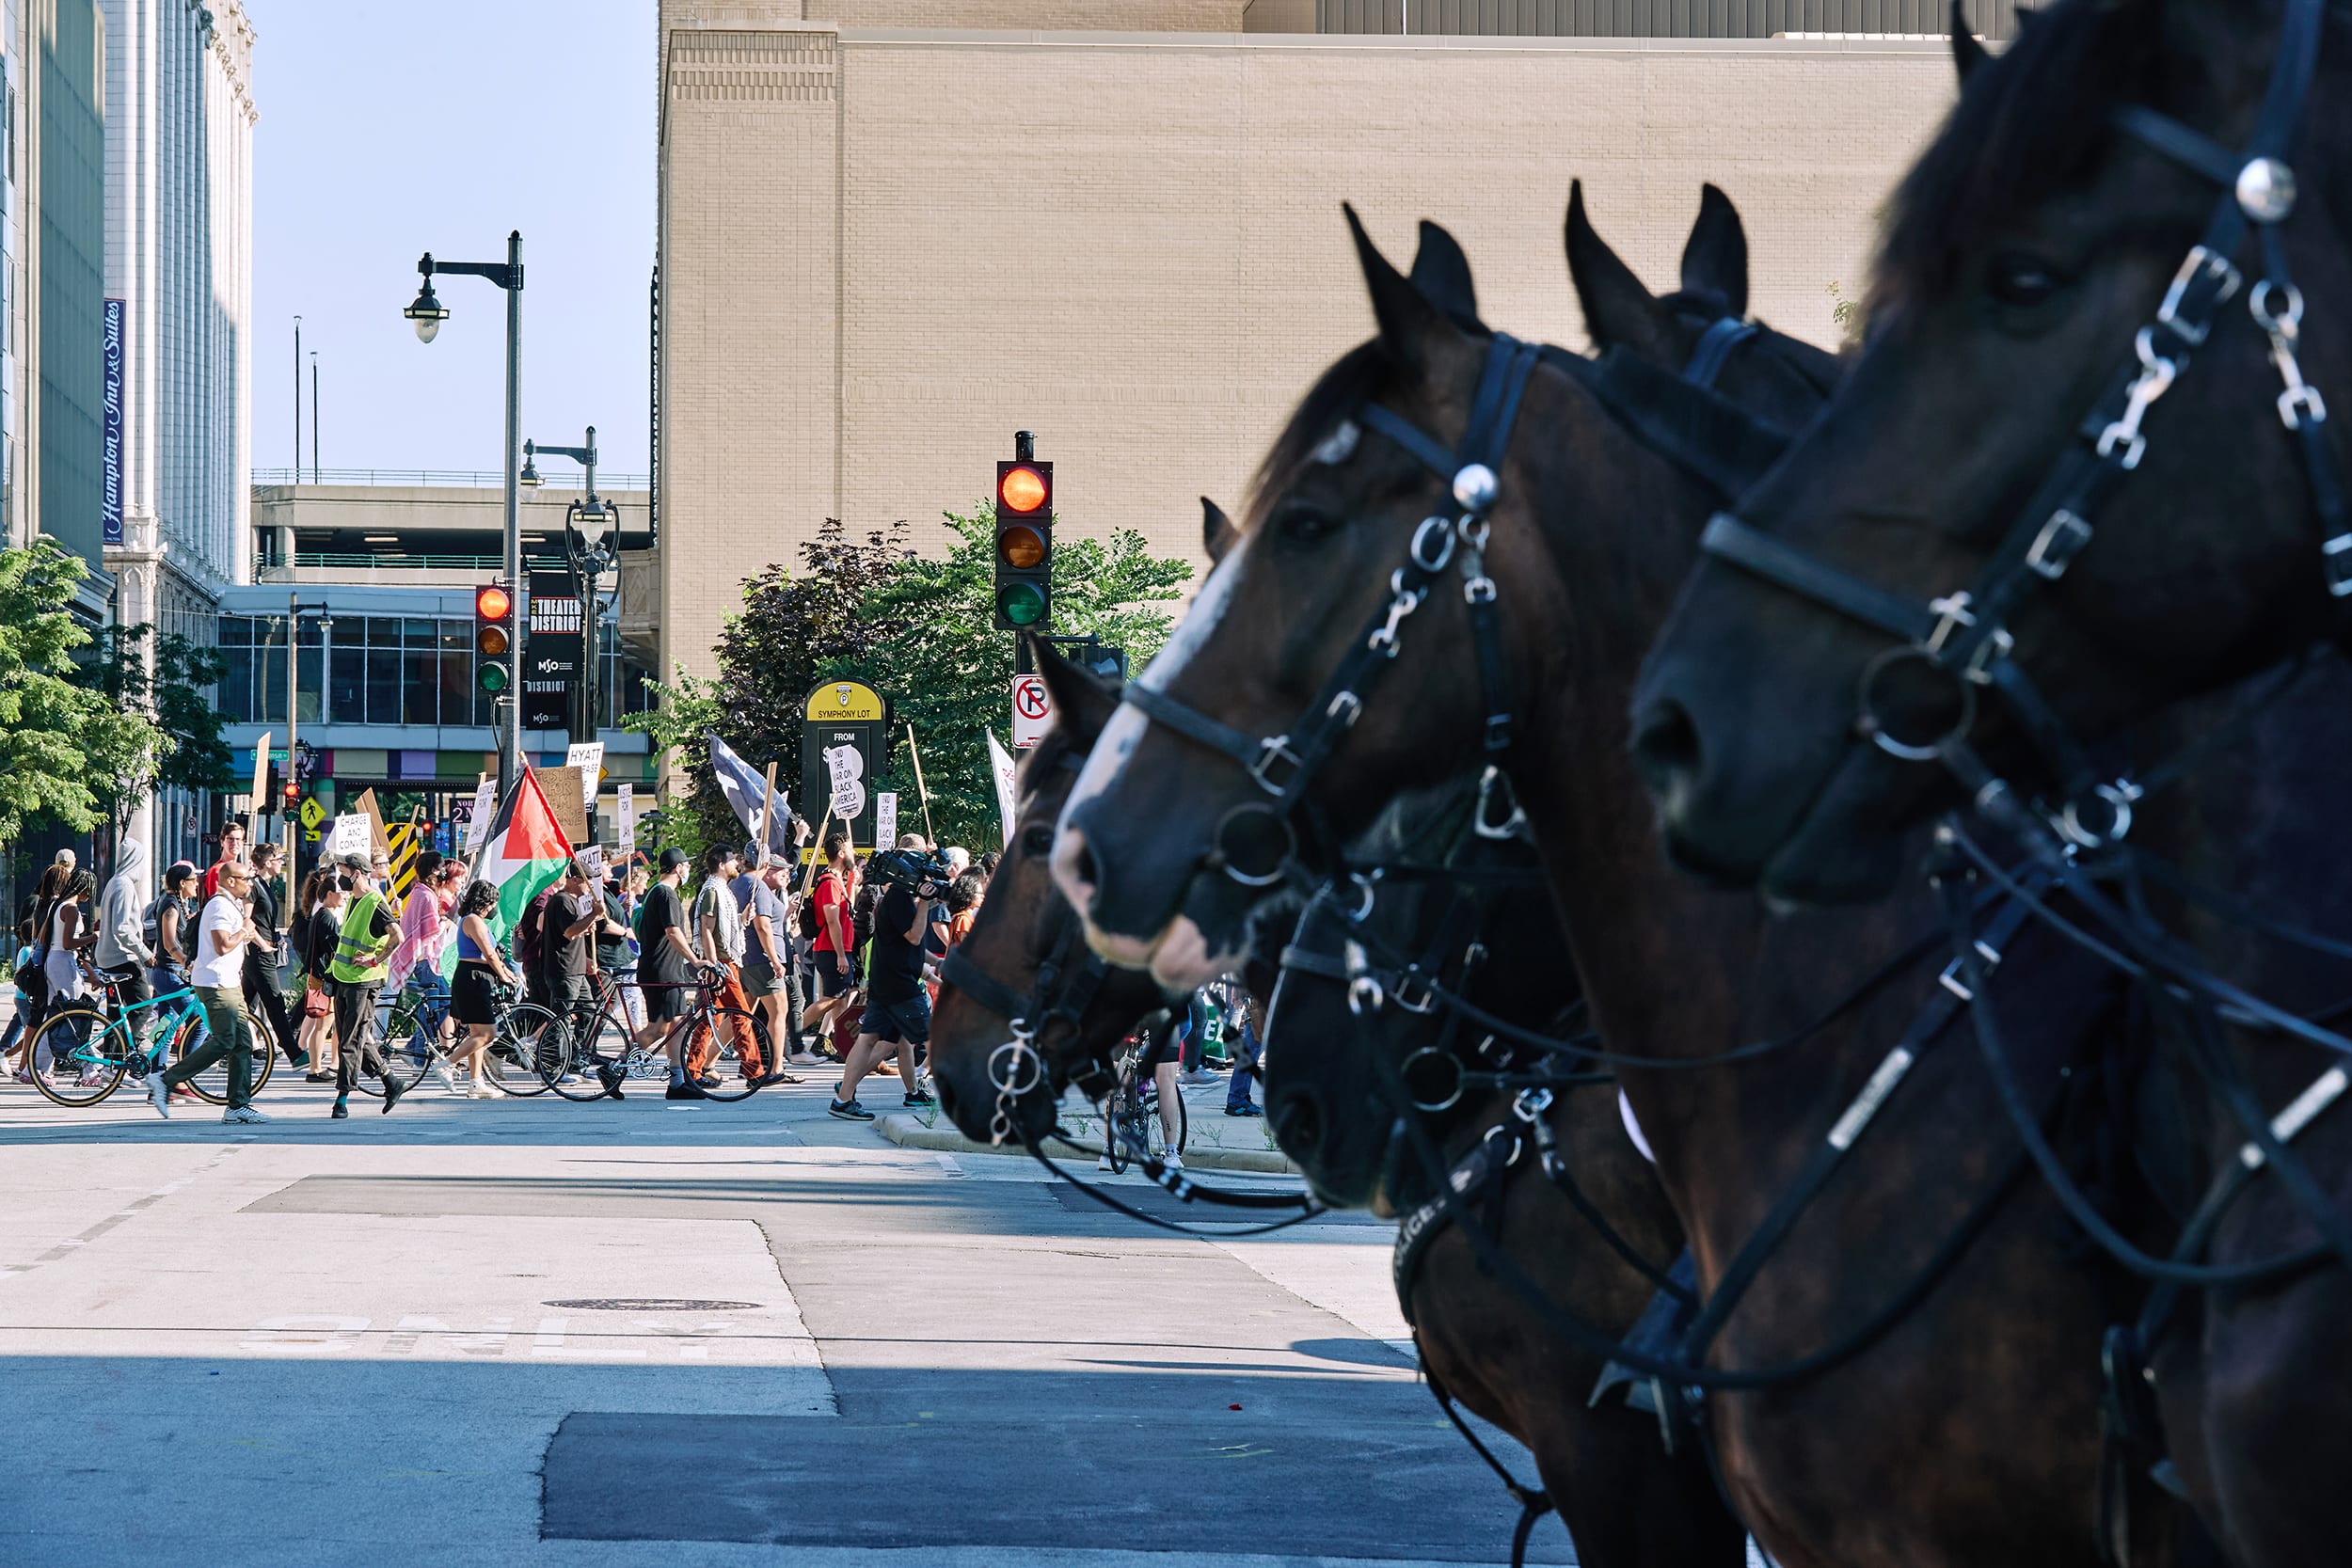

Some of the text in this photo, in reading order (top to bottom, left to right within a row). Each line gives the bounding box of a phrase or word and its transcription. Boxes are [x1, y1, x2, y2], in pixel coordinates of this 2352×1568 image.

[103, 301, 121, 534] Hampton Inn & Suites
[538, 599, 581, 615] THEATER
[531, 615, 581, 631] DISTRICT
[538, 658, 559, 673] MSO
[527, 680, 565, 692] DISTRICT
[533, 713, 554, 724] MSO
[818, 710, 871, 719] SYMPHONY LOT
[834, 733, 855, 742] FROM
[570, 749, 601, 762] HYATT
[341, 815, 367, 828] CHARGE
